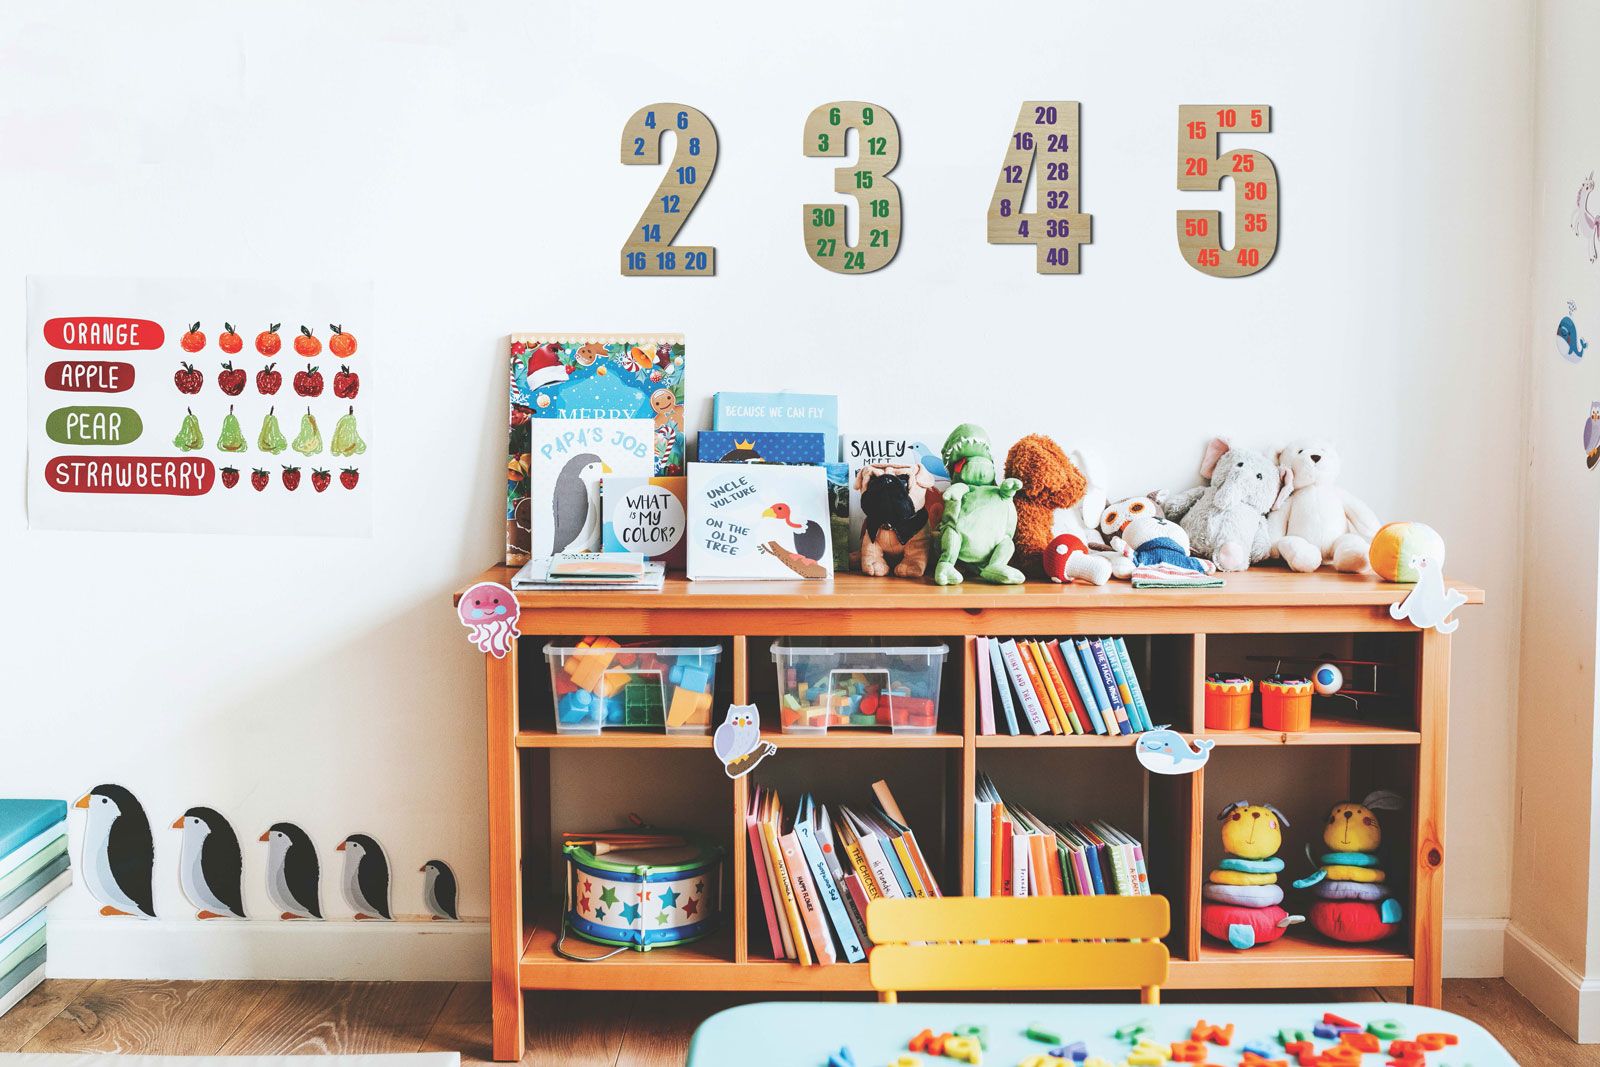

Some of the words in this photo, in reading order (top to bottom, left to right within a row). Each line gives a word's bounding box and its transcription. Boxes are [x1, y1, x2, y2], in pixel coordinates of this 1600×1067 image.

[645, 111, 656, 129] 4
[677, 111, 689, 129] 6
[829, 107, 841, 126] 6
[862, 107, 874, 126] 9
[1035, 106, 1057, 125] 20
[1216, 109, 1237, 128] 10
[1251, 109, 1262, 128] 5
[1186, 121, 1207, 140] 15
[634, 137, 645, 156] 2
[689, 137, 700, 156] 8
[818, 134, 829, 152] 3
[868, 137, 887, 155] 12
[1013, 132, 1033, 150] 16
[1047, 134, 1068, 152] 24
[1047, 162, 1069, 181] 28
[1185, 157, 1208, 176] 20
[1232, 154, 1254, 173] 25
[676, 166, 696, 185] 10
[854, 171, 873, 189] 15
[1003, 165, 1022, 184] 12
[621, 103, 719, 276] 2
[803, 101, 903, 275] 3
[987, 101, 1093, 275] 4
[1177, 105, 1280, 278] 5
[1244, 181, 1267, 200] 30
[660, 195, 680, 213] 12
[870, 199, 889, 218] 18
[1000, 199, 1011, 217] 8
[1047, 191, 1069, 209] 32
[812, 208, 835, 227] 30
[1244, 213, 1268, 233] 35
[641, 224, 661, 242] 14
[1018, 220, 1029, 238] 4
[1046, 219, 1069, 238] 36
[1185, 218, 1208, 237] 50
[816, 238, 836, 257] 27
[870, 229, 889, 247] 21
[626, 252, 646, 270] 16
[656, 252, 676, 270] 18
[685, 252, 707, 270] 20
[844, 251, 865, 270] 24
[1046, 248, 1069, 266] 40
[1197, 249, 1220, 267] 45
[1237, 249, 1259, 267] 40
[62, 322, 140, 347] ORANGE
[61, 363, 119, 389] APPLE
[725, 405, 766, 417] BECAUSE
[769, 406, 783, 418] WE
[787, 407, 805, 418] CAN
[808, 407, 824, 418] FLY
[66, 412, 122, 441] PEAR
[540, 427, 604, 460] PAPA'S
[611, 430, 648, 458] JOB
[851, 440, 906, 457] SALLEY
[55, 462, 206, 490] STRAWBERRY
[706, 476, 748, 499] UNCLE
[710, 485, 757, 509] VULTURE
[626, 494, 671, 510] WHAT
[622, 526, 676, 543] COLOR?
[706, 518, 723, 529] ON
[728, 523, 750, 536] THE
[711, 530, 738, 544] OLD
[705, 539, 739, 556] TREE
[1101, 663, 1112, 685] MAGIC
[1016, 674, 1026, 687] AND
[1021, 689, 1032, 702] THE
[851, 847, 863, 865] THE
[858, 865, 881, 899] CHICKEN
[796, 875, 807, 893] HAPPY
[802, 892, 814, 912] FLOWER
